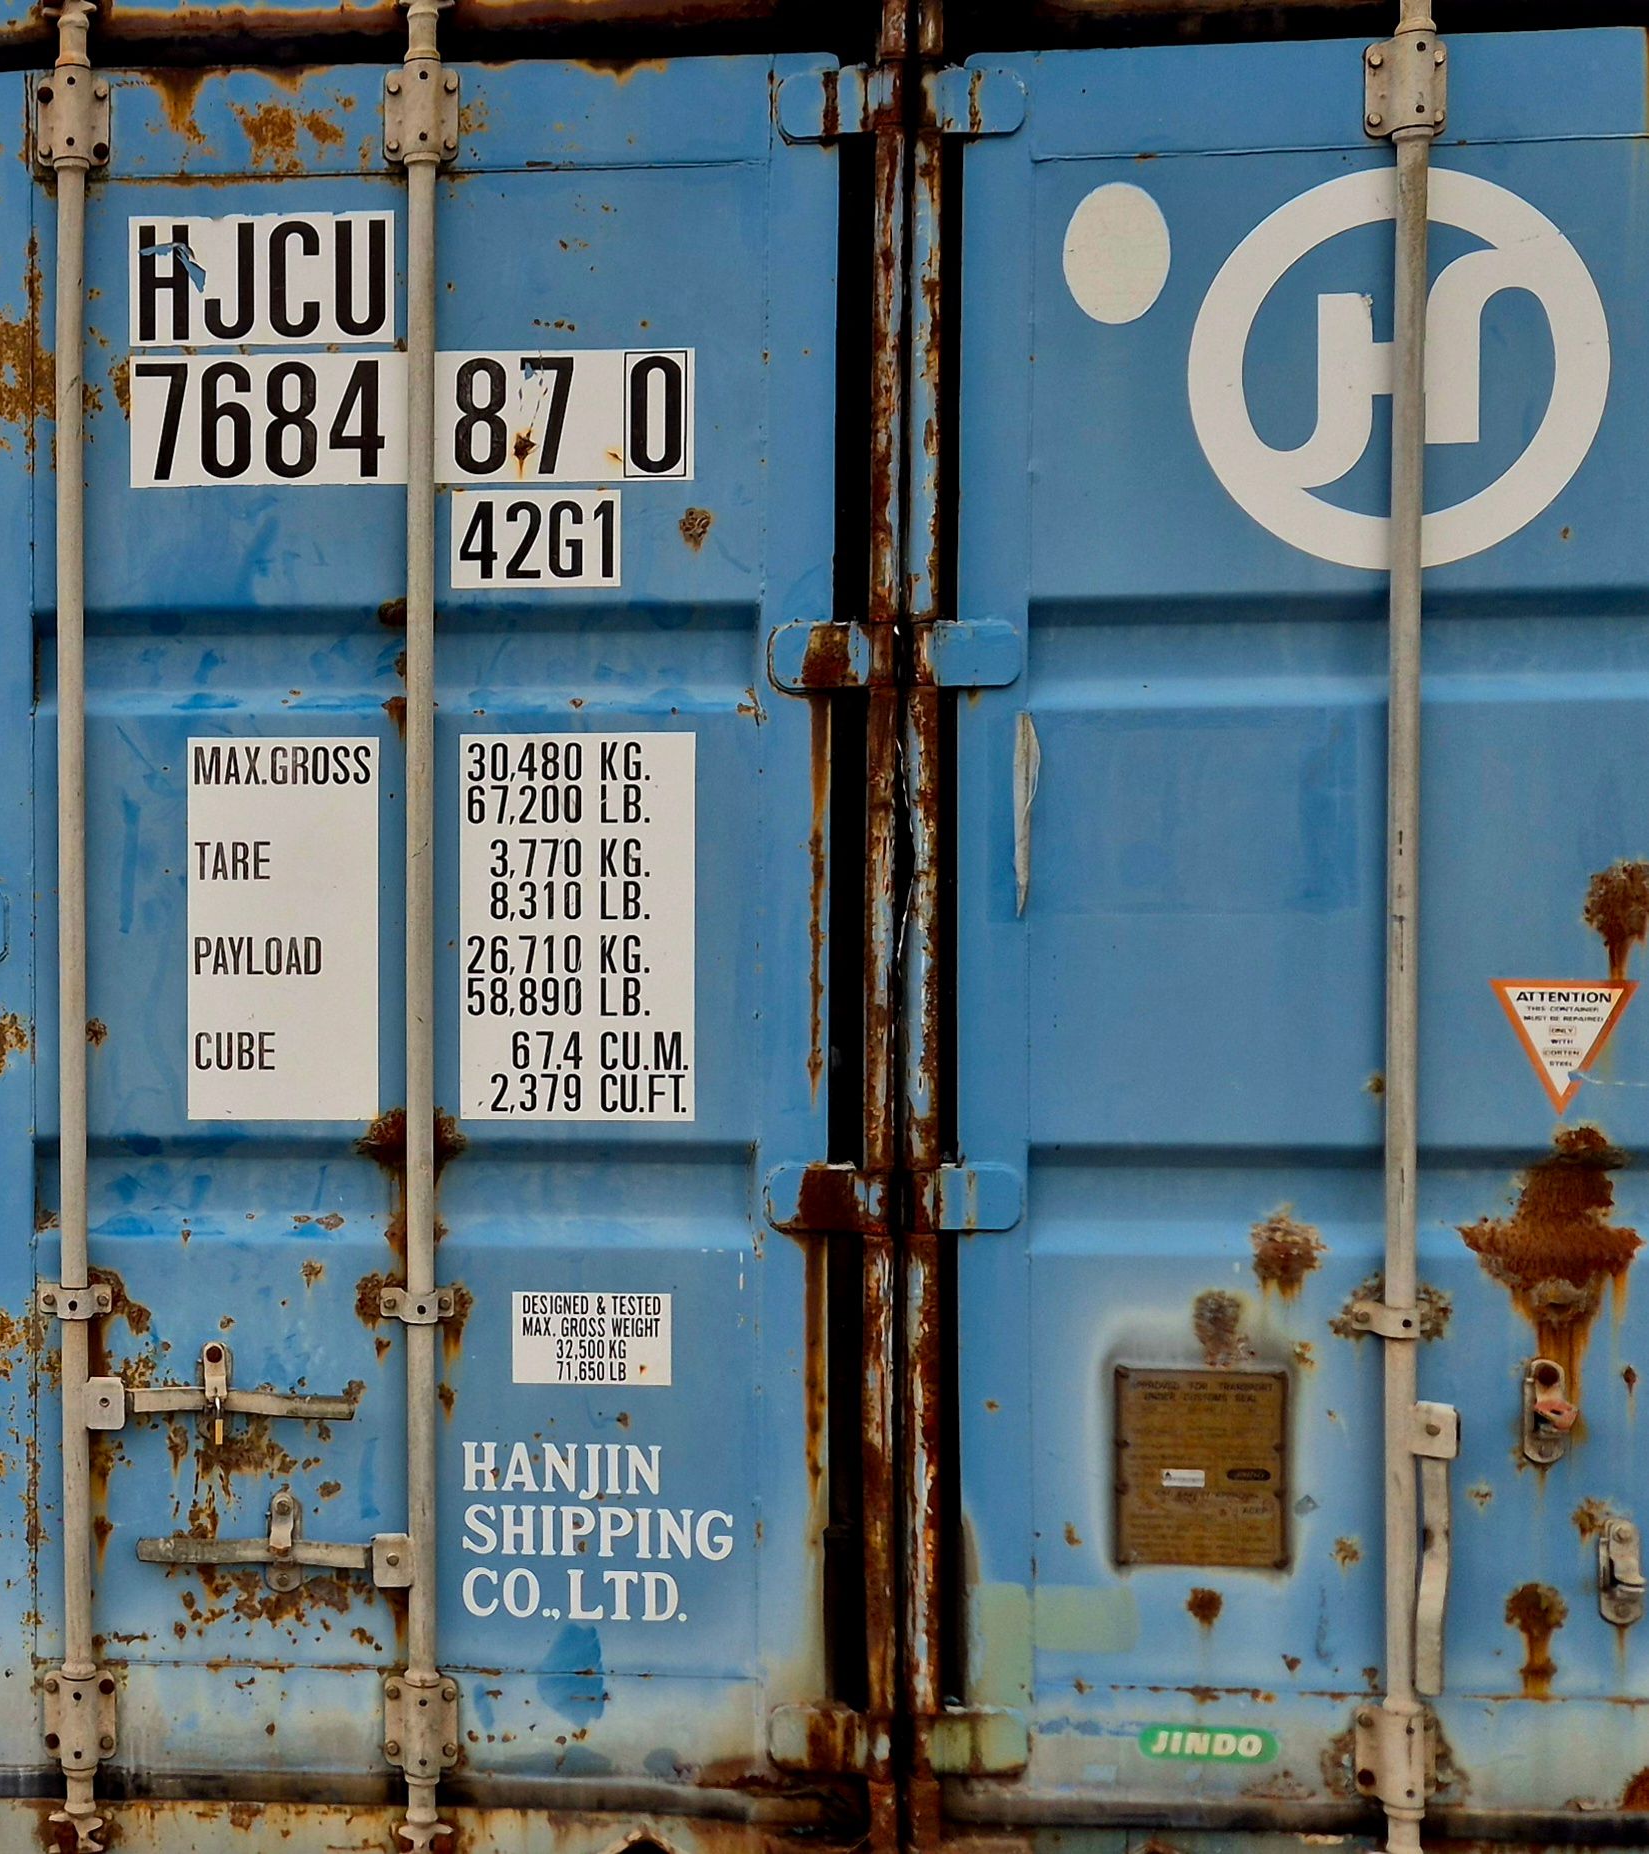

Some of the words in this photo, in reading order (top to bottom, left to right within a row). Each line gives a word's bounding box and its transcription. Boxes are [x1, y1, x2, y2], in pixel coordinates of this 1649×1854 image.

[139, 219, 386, 341] HJCU
[135, 360, 385, 481] 7684
[454, 356, 575, 475] 87
[630, 354, 682, 474] 0
[459, 500, 615, 580] 42G1
[194, 746, 371, 785] MAX.GROSS
[467, 742, 582, 783] 30,480
[600, 742, 650, 781] KG.
[467, 785, 582, 826] 67,200
[600, 785, 650, 824] LB.
[194, 841, 271, 880] TARE
[490, 838, 582, 880] 3,770
[600, 839, 650, 878] KG.
[490, 881, 582, 922] 8,310
[600, 881, 650, 920] LB.
[194, 936, 322, 976] PAYLOAD
[467, 936, 582, 977] 26,710
[600, 936, 650, 975] KG.
[467, 978, 582, 1019] 58,890
[600, 978, 650, 1016] LB.
[1516, 991, 1611, 1003] ATTENTION
[195, 1032, 276, 1071] CUBE
[512, 1031, 582, 1071] 67.4
[600, 1031, 689, 1071] CU.M.
[490, 1074, 582, 1114] 2,379
[600, 1074, 687, 1113] CU.FT.
[522, 1295, 589, 1315] DESIGNED
[596, 1296, 606, 1315] &
[612, 1296, 661, 1315] TESTED
[522, 1317, 556, 1337] MAX.
[561, 1318, 605, 1337] GROSS
[612, 1318, 661, 1338] WEIGHT
[556, 1339, 605, 1360] 32,500
[608, 1339, 627, 1359] KG
[557, 1361, 605, 1382] 71,650
[609, 1361, 627, 1381] LB
[462, 1441, 662, 1500] HANJIN
[462, 1504, 733, 1561] SHIPPING
[1152, 1730, 1263, 1757] JINDO
